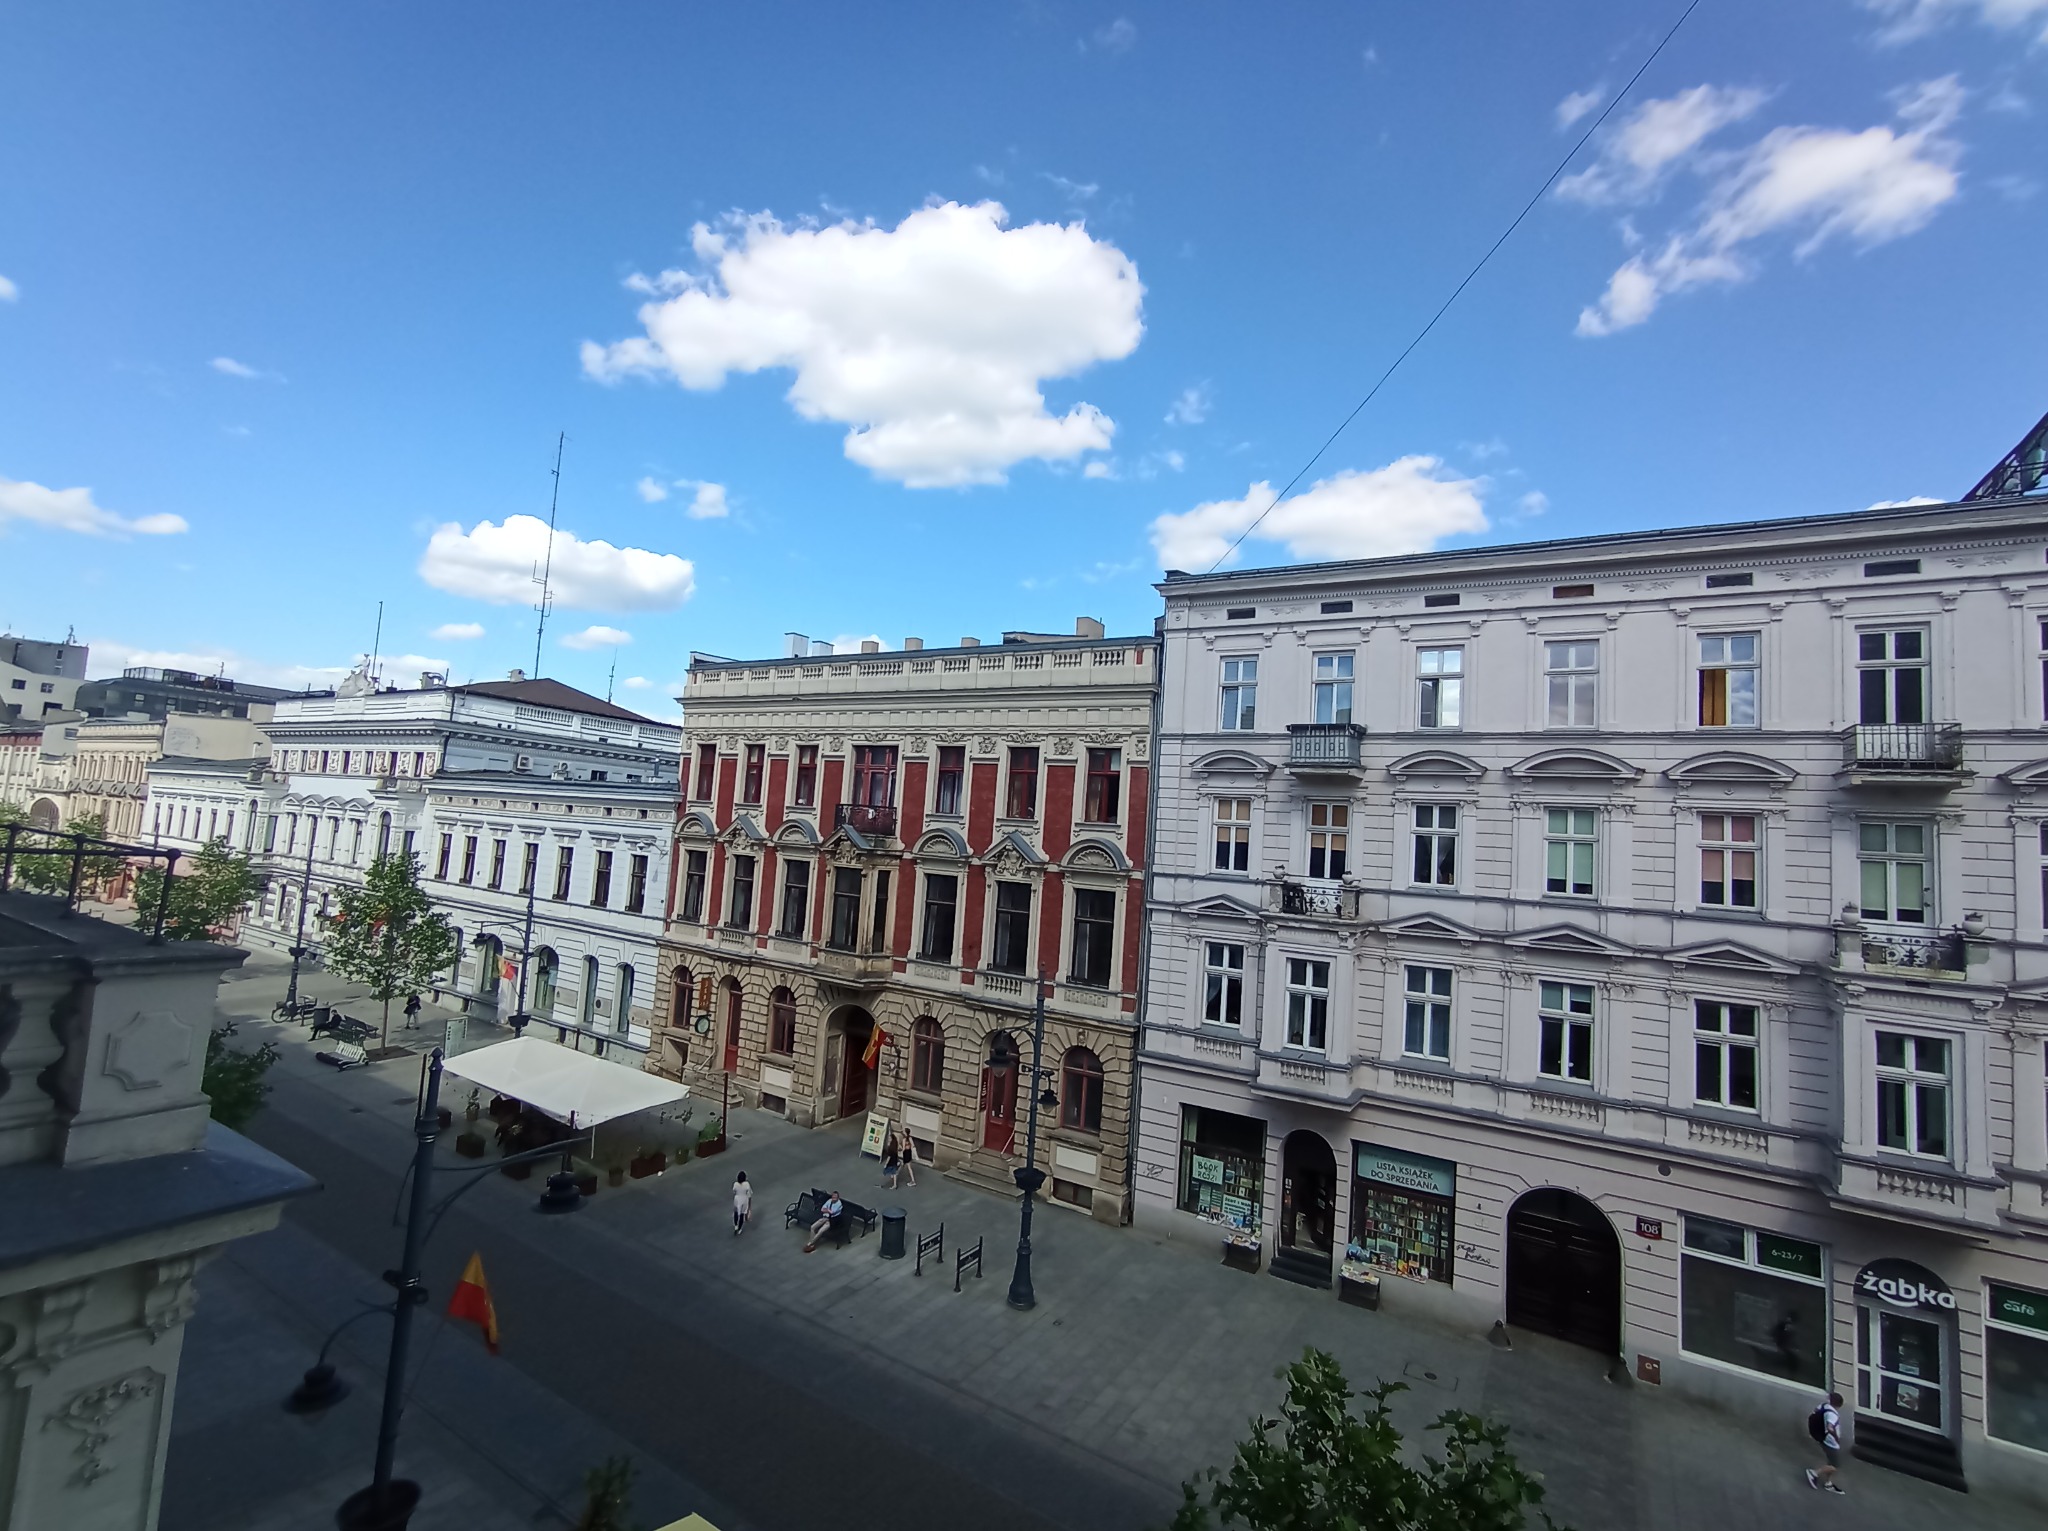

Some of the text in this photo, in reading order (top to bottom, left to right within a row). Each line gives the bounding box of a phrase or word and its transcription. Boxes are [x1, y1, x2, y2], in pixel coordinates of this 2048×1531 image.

[1197, 1161, 1219, 1173] BOOK
[1376, 1161, 1434, 1181] LISTA KSIĄŻEK
[1370, 1169, 1439, 1192] DO SPRZEDANIA
[1639, 1222, 1659, 1235] 108
[1771, 1249, 1803, 1261] 6-23/7
[1862, 1270, 1956, 1309] żabka
